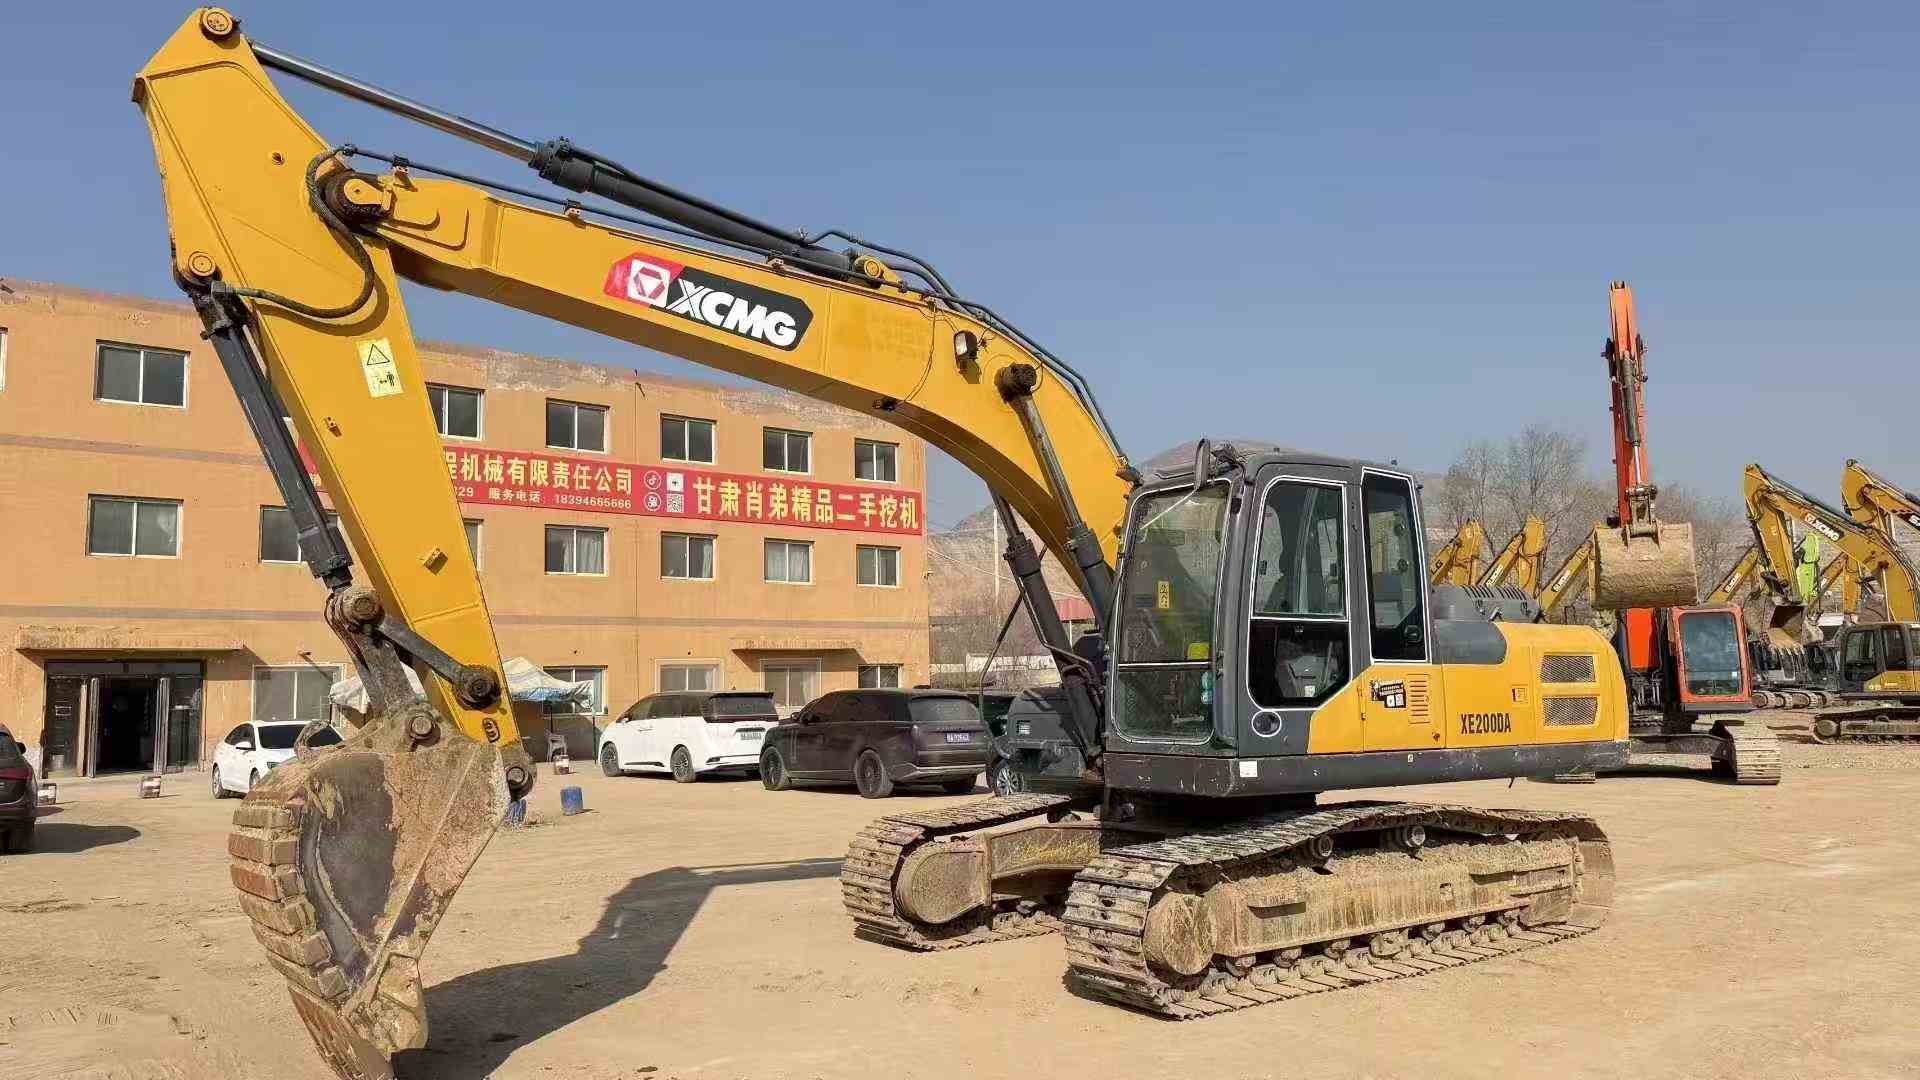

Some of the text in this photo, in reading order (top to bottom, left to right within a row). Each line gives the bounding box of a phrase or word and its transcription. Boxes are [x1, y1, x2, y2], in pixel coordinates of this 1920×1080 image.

[666, 278, 798, 348] XCMG
[455, 486, 474, 497] 29
[693, 476, 919, 529] 甘肃肖弟精品二手挖机
[1461, 712, 1512, 734] XE200DA
